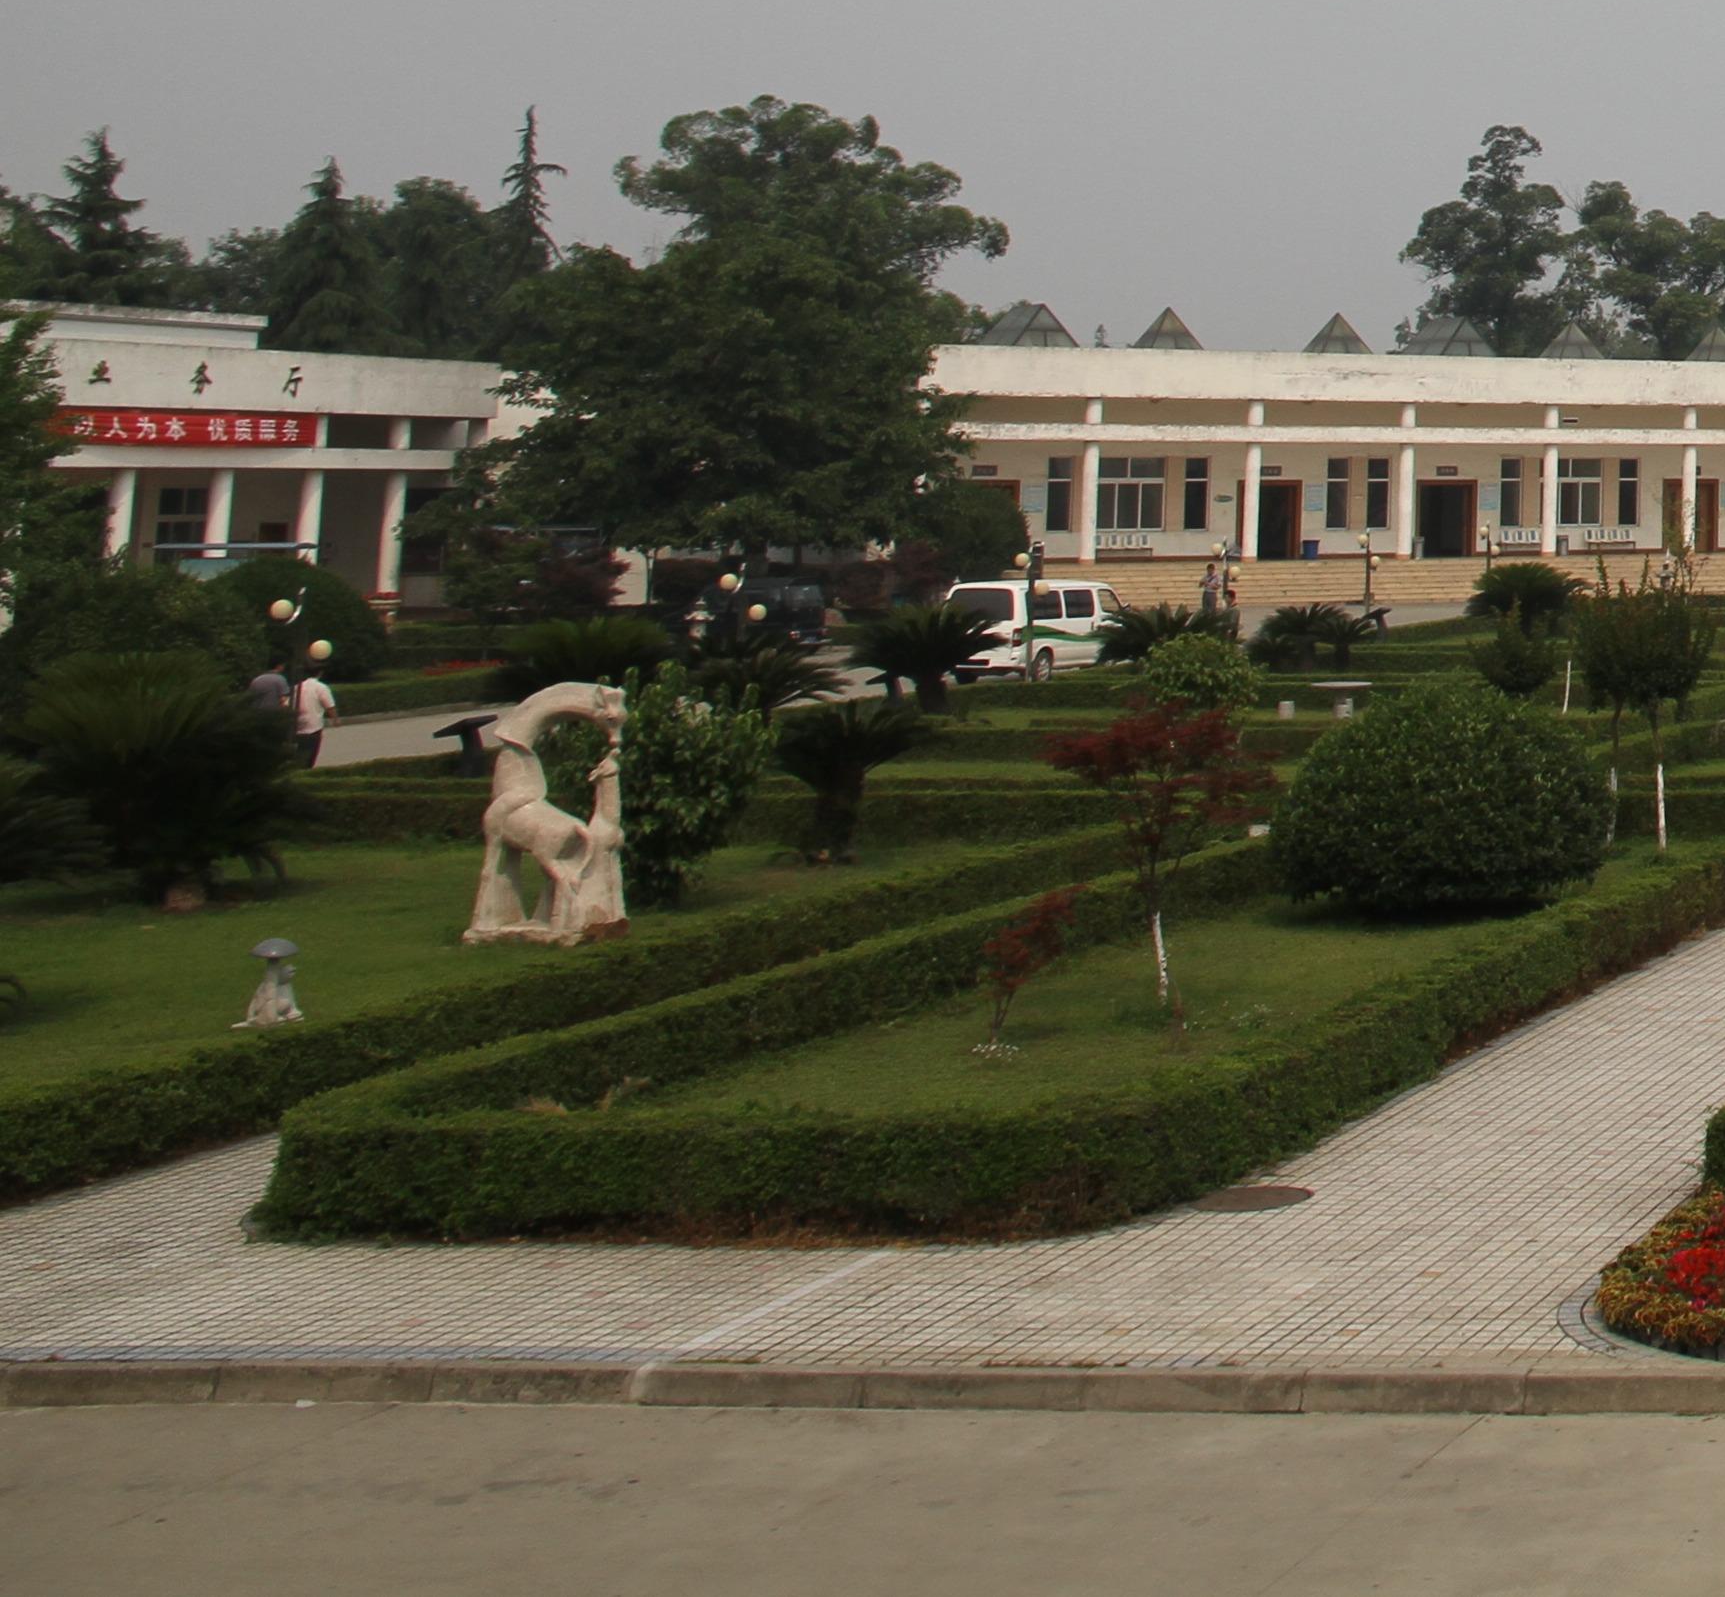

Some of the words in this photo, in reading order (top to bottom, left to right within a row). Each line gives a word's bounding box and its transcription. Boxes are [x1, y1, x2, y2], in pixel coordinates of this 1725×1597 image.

[88, 360, 303, 398] 业务厅
[207, 417, 300, 442] 优质服务
